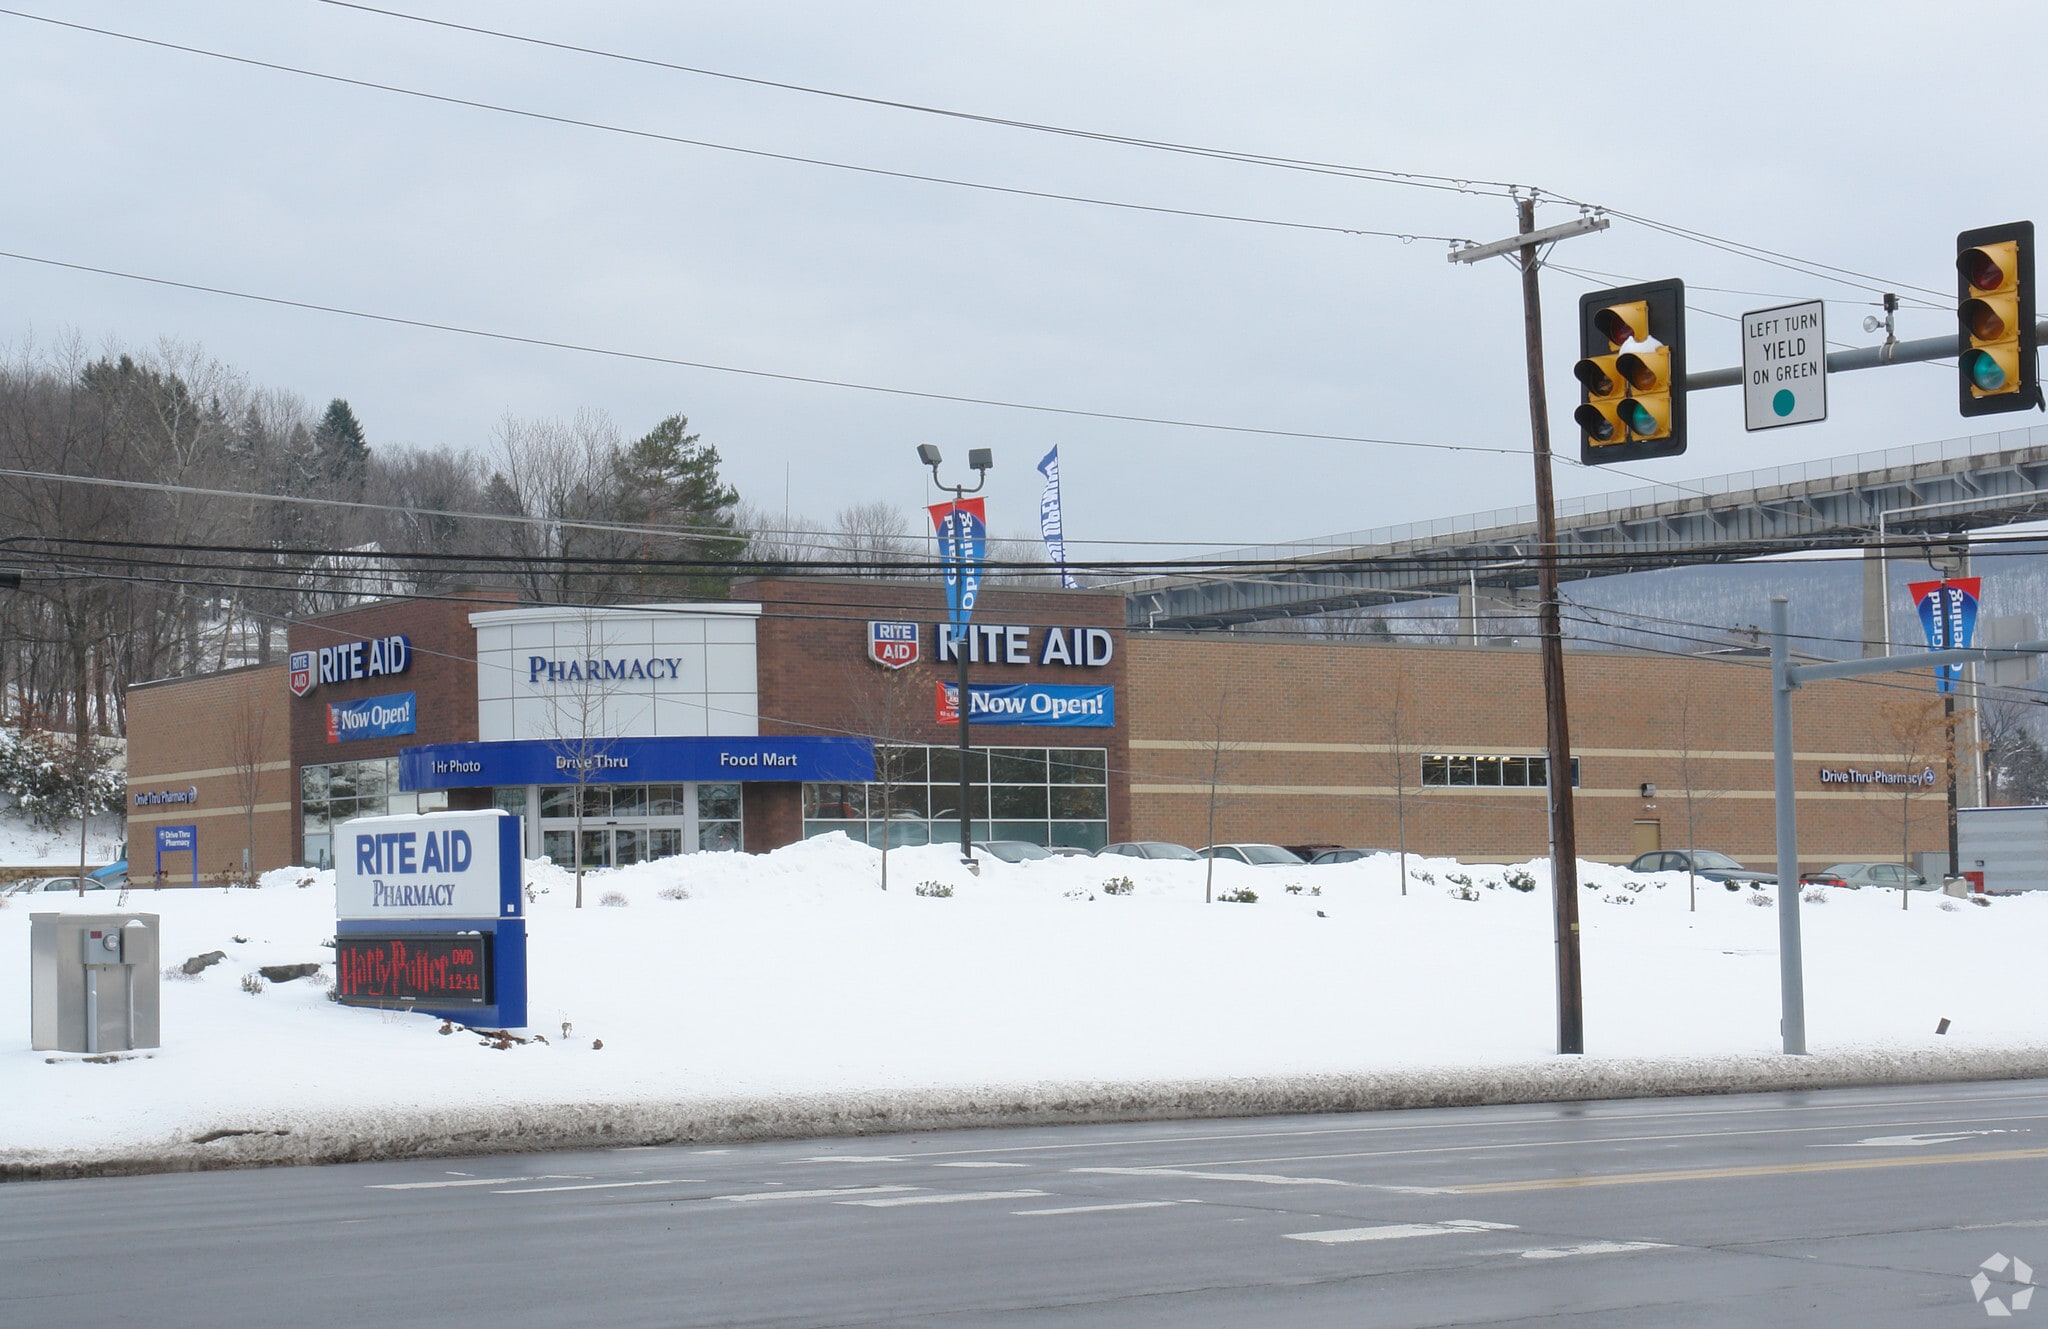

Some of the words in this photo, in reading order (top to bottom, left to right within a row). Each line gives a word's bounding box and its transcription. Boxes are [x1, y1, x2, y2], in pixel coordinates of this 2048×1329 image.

[1750, 319, 1779, 339] LEFT
[1785, 312, 1818, 332] TURN
[1762, 337, 1806, 361] YIELD
[1753, 368, 1770, 385] ON
[1776, 361, 1818, 382] GREEN
[1927, 591, 1944, 650] Grand
[879, 624, 912, 640] RITE
[882, 643, 910, 660] AID
[1041, 626, 1114, 667] AID
[293, 656, 308, 670] RITE
[319, 641, 364, 684] RITE
[368, 635, 406, 678] AID
[527, 655, 683, 683] PHARMACY
[293, 673, 307, 688] AID
[341, 709, 370, 730] Now
[370, 701, 410, 730] Open!
[970, 691, 1026, 715] Now
[1030, 692, 1104, 719] Open!
[431, 761, 437, 774] 1
[437, 762, 449, 774] Hr
[449, 759, 481, 774] Photo
[555, 755, 593, 770] Drive
[594, 754, 629, 769] Thru
[719, 752, 759, 768] Food
[762, 752, 798, 768] Mart
[1821, 768, 1849, 783] Drive
[1848, 768, 1872, 783] Thru
[1874, 770, 1923, 787] Pharmacy
[165, 831, 179, 839] Drive
[179, 830, 191, 838] Thru
[165, 839, 190, 847] Pharmacy
[356, 832, 417, 875] RITE
[421, 829, 473, 874] AID
[372, 879, 456, 908] PHARMACY
[452, 948, 475, 965] DVD
[341, 946, 391, 996] Harry
[390, 940, 449, 996] Potter
[448, 973, 480, 990] 12-11
